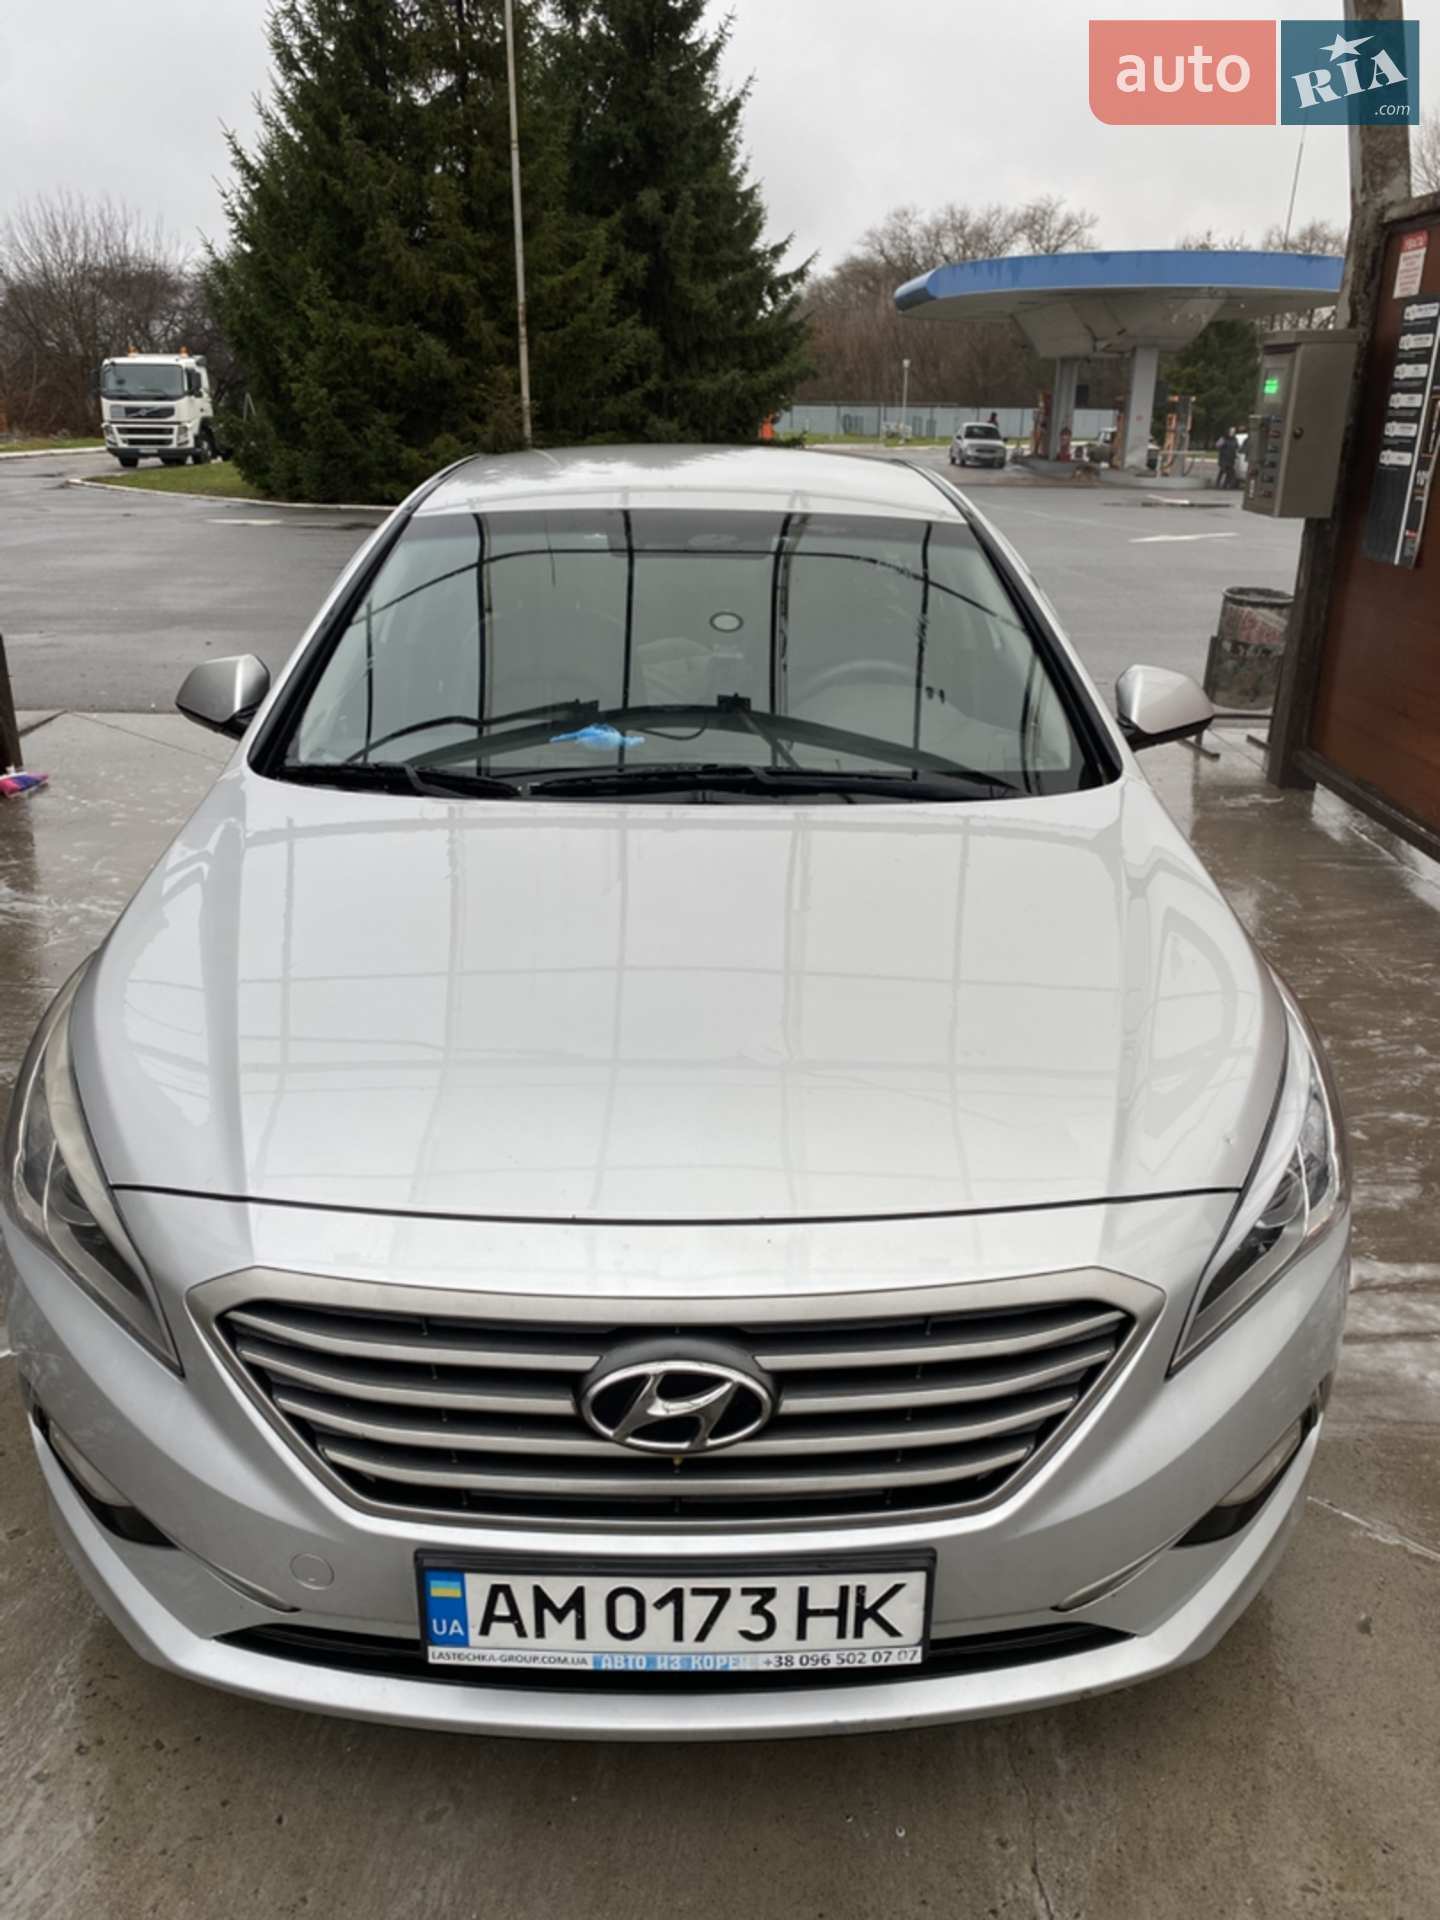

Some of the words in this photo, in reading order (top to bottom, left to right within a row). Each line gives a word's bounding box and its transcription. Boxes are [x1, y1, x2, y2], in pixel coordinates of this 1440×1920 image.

[478, 1583, 587, 1641] AM
[605, 1586, 777, 1643] 0173
[796, 1583, 908, 1640] HK
[432, 1618, 465, 1637] UA
[763, 1654, 795, 1668] +38
[799, 1653, 832, 1667] 096
[835, 1651, 867, 1666] 502
[871, 1650, 893, 1664] 07
